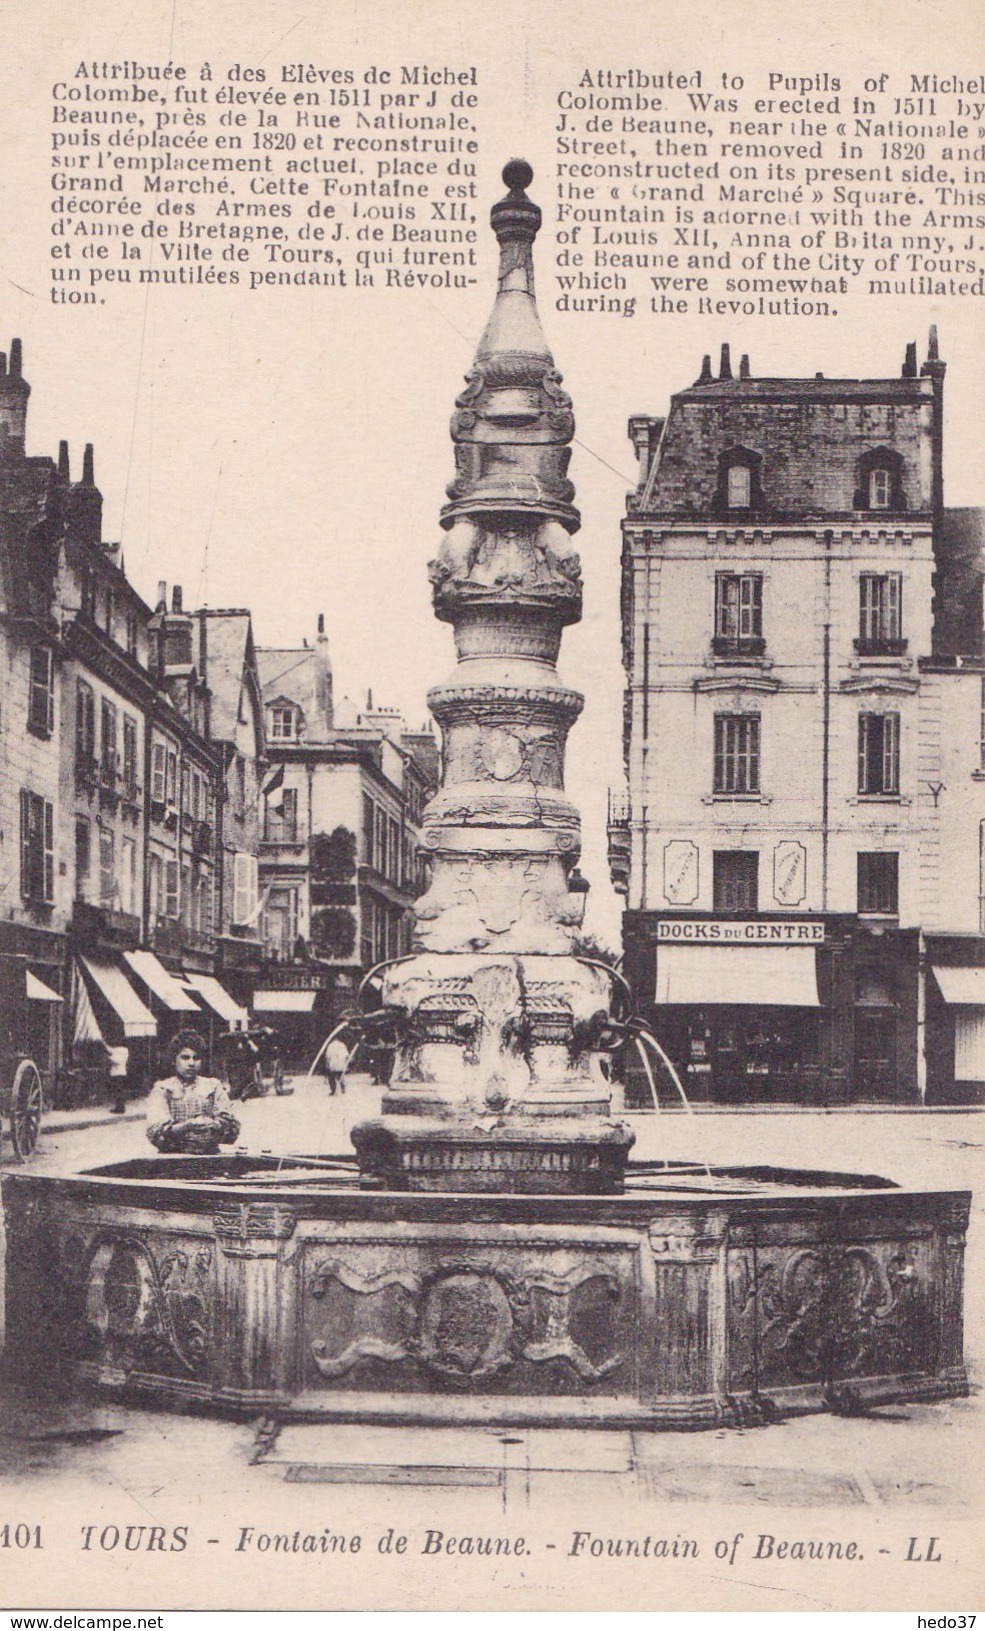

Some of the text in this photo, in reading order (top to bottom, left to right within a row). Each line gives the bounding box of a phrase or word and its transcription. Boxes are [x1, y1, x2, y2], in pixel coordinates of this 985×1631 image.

[660, 924, 823, 939] DOCKS DU CENTRE
